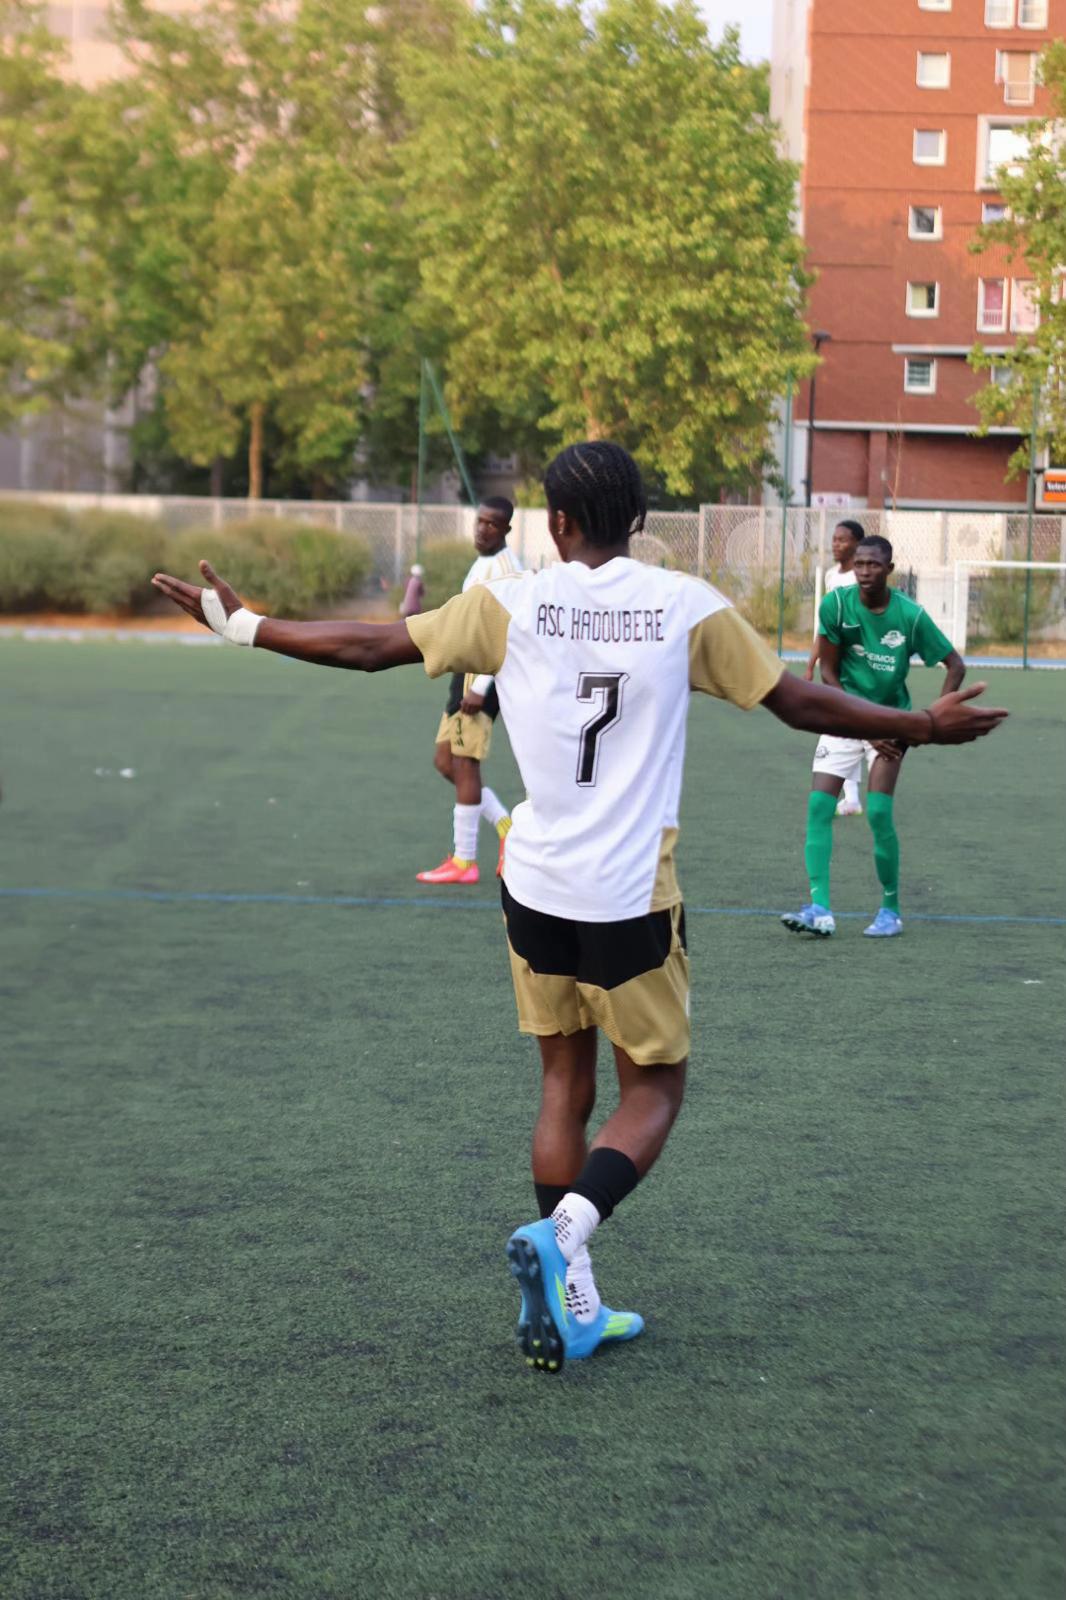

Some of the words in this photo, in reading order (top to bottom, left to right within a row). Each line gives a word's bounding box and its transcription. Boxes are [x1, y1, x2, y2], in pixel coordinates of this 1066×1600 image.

[536, 603, 566, 638] ASC
[570, 607, 665, 643] HADOUBERE
[576, 671, 630, 787] 7
